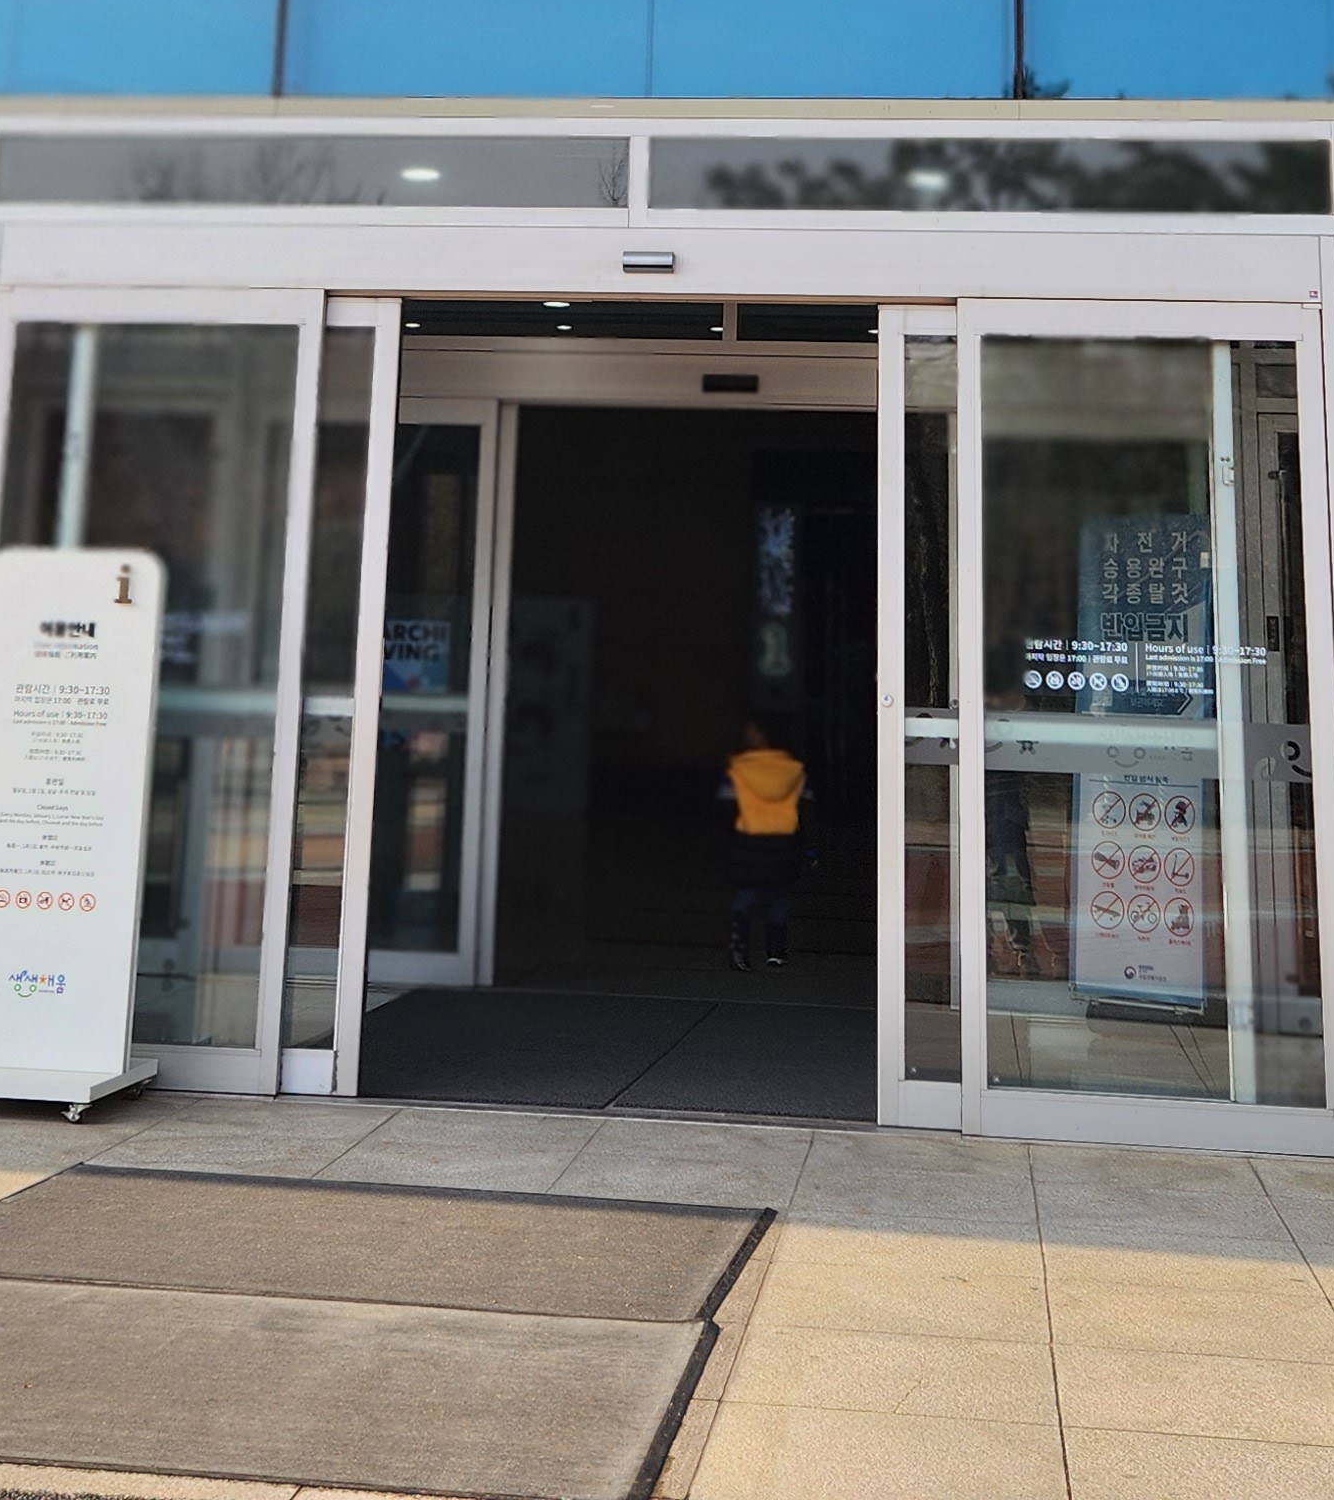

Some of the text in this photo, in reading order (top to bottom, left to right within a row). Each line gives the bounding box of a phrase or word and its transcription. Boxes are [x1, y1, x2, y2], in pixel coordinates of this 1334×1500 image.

[1100, 611, 1189, 643] 반입금지
[1145, 643, 1174, 653] Hours
[1175, 644, 1186, 653] of
[1187, 646, 1204, 654] use
[1067, 654, 1087, 663] 17:00
[1159, 654, 1190, 662] admission
[16, 684, 50, 694] 관람시간
[8, 970, 66, 994] 생생채움
